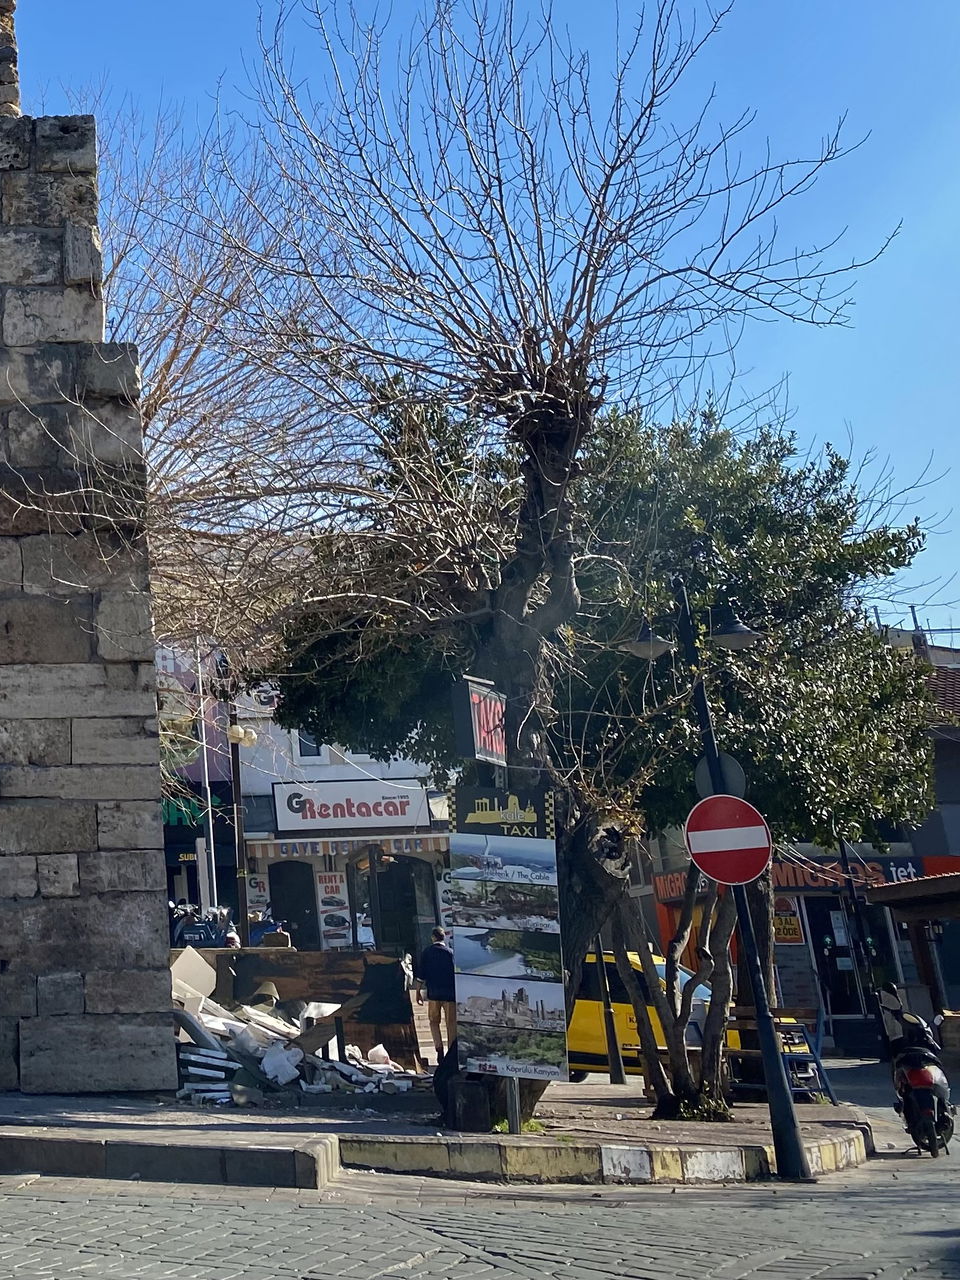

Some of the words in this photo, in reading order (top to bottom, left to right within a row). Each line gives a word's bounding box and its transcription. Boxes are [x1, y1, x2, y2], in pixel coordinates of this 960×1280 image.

[501, 824, 538, 837] TAXI
[318, 874, 337, 884] RENT
[339, 873, 345, 884] A
[324, 884, 341, 895] CAR
